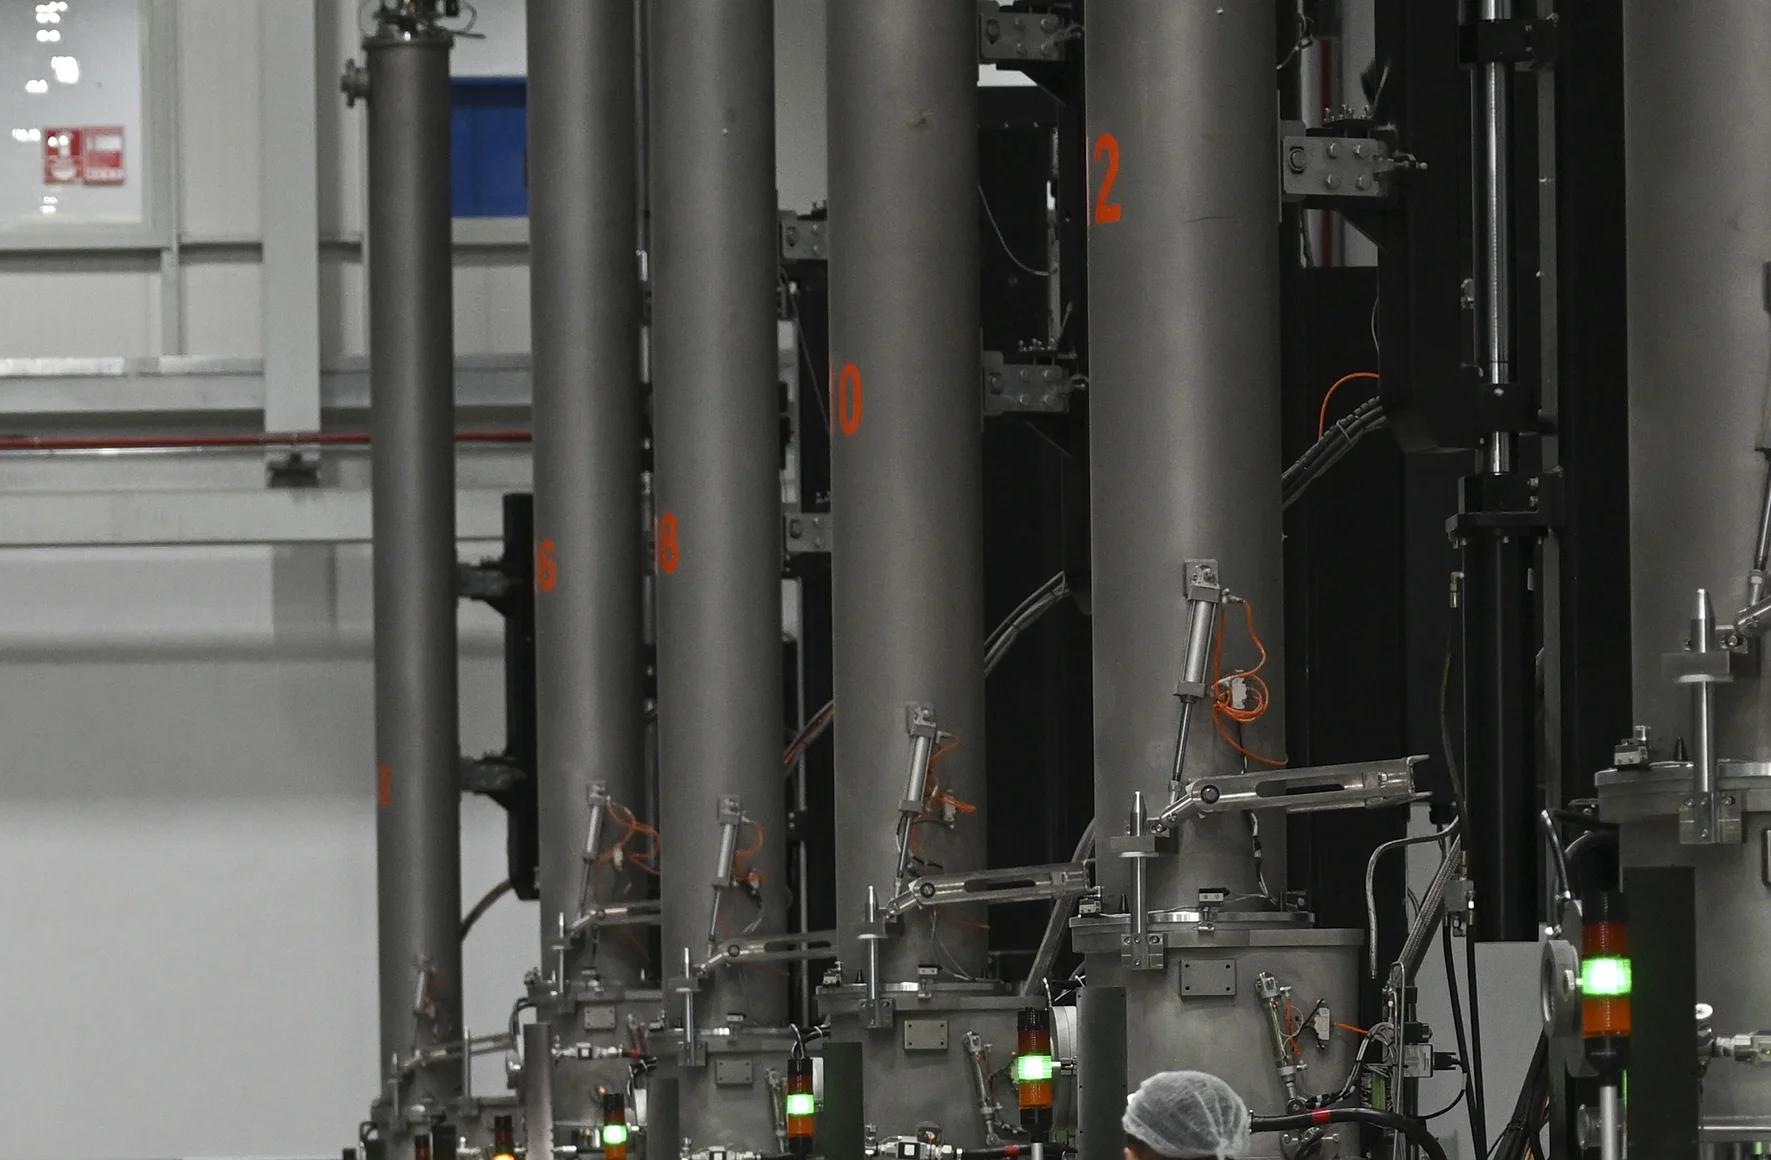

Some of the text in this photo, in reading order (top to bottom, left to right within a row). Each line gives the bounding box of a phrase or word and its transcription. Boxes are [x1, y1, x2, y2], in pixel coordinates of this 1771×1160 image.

[1093, 132, 1122, 225] 2
[830, 362, 864, 436] 0
[535, 538, 557, 592] 6
[656, 511, 681, 574] 8
